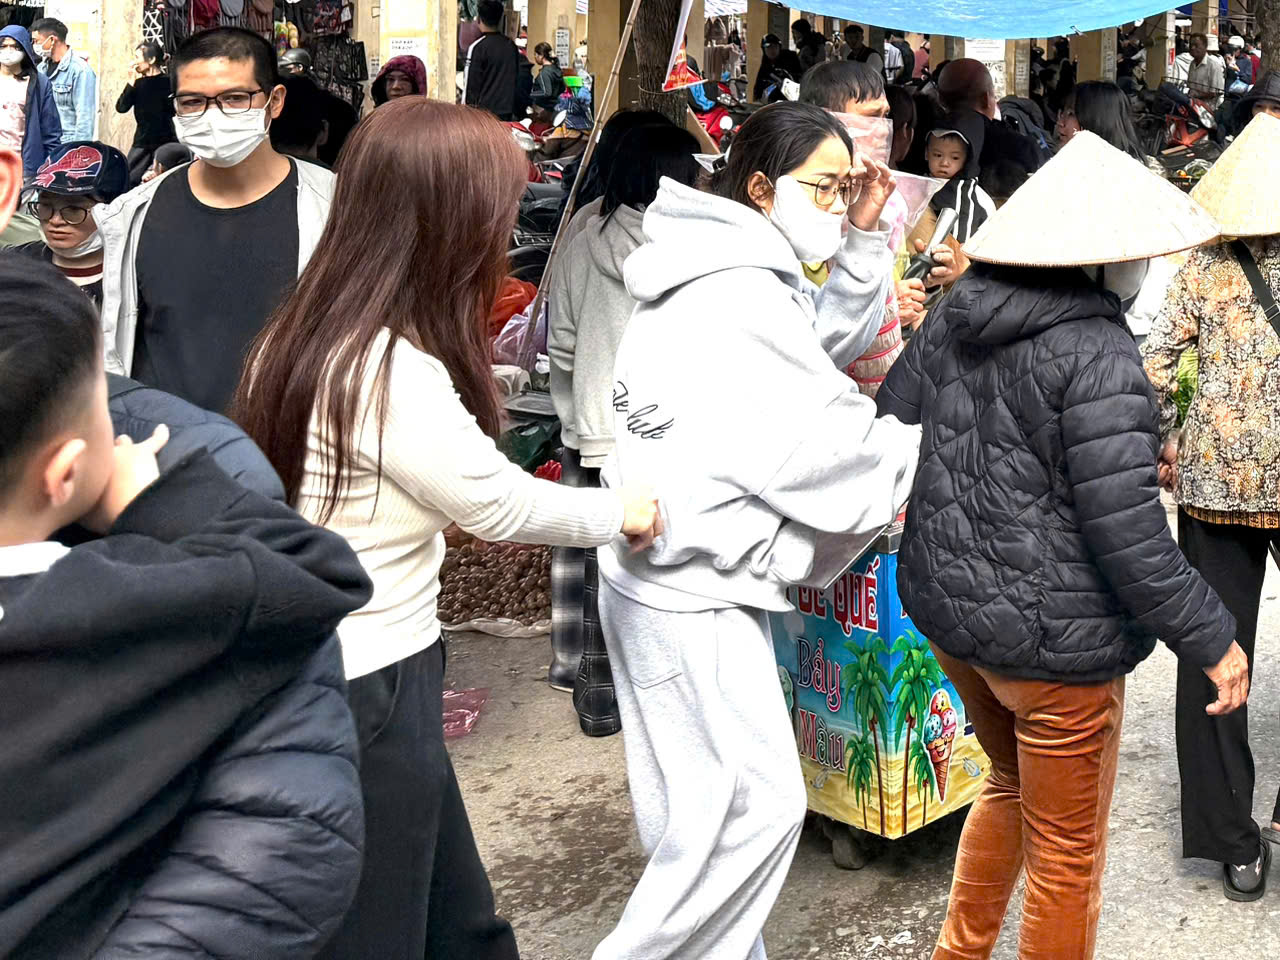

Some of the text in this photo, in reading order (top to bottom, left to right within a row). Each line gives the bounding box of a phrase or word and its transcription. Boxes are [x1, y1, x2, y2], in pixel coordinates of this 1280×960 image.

[833, 555, 880, 638] QUẾ
[797, 637, 842, 713] Bẩy
[798, 707, 846, 771] Màu
